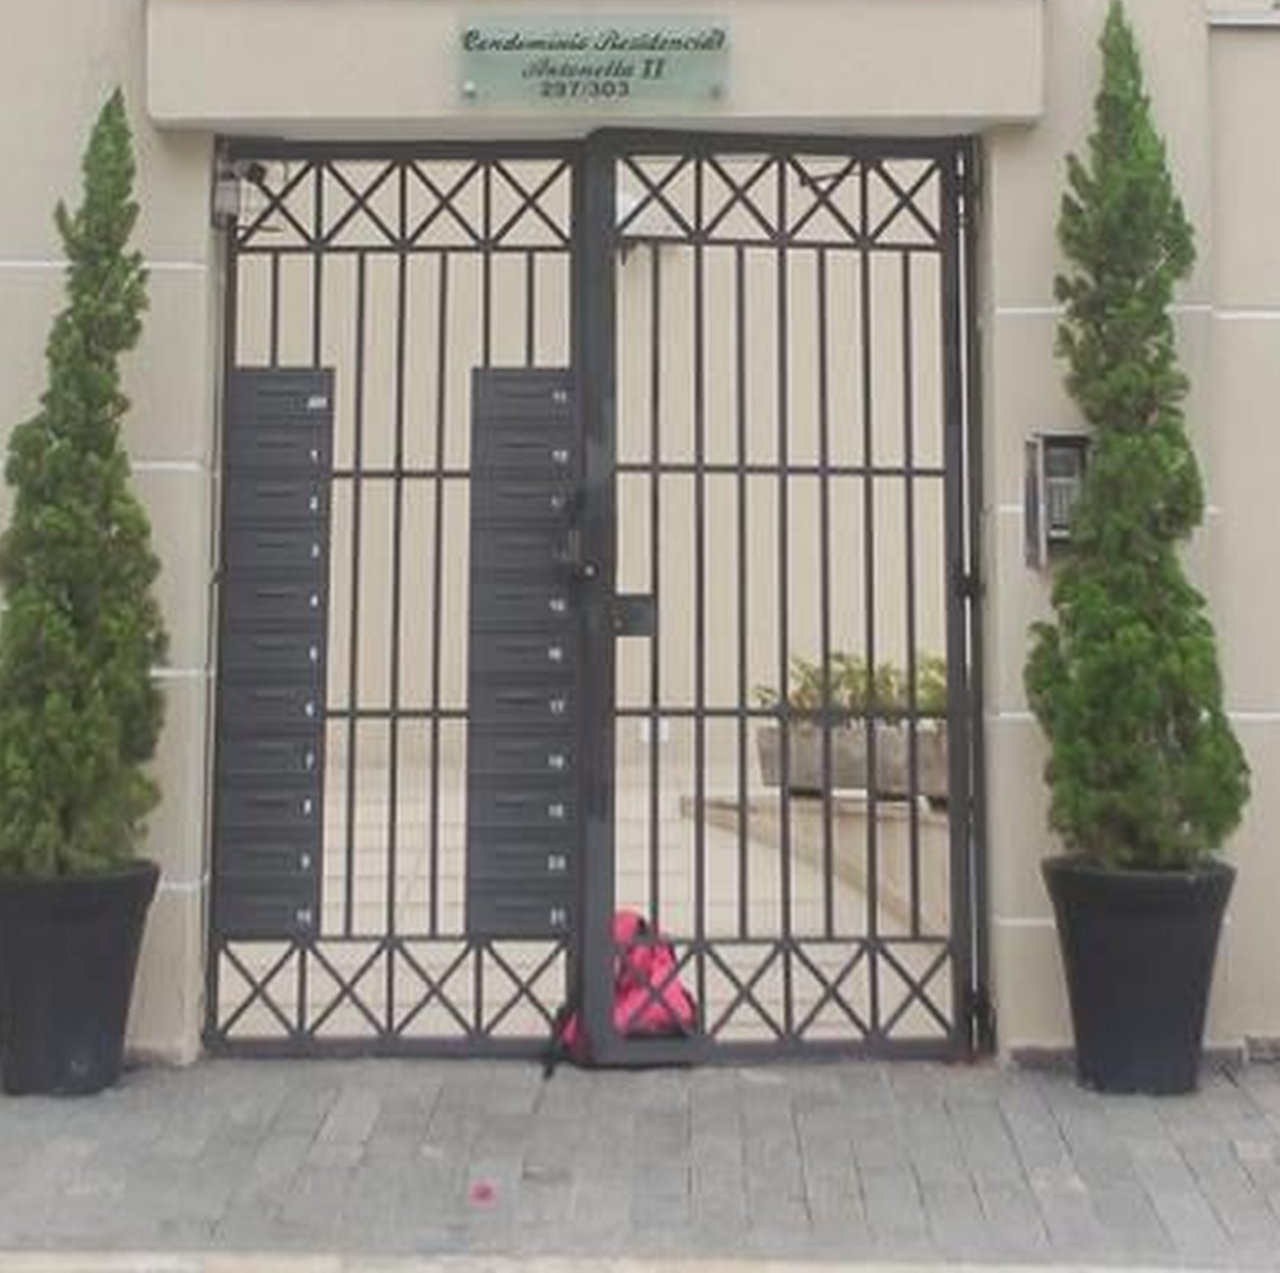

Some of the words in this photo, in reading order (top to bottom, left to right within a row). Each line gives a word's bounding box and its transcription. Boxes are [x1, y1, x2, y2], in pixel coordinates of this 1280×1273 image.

[521, 57, 634, 79] Antonella
[642, 58, 665, 80] II
[540, 80, 631, 98] 297/303
